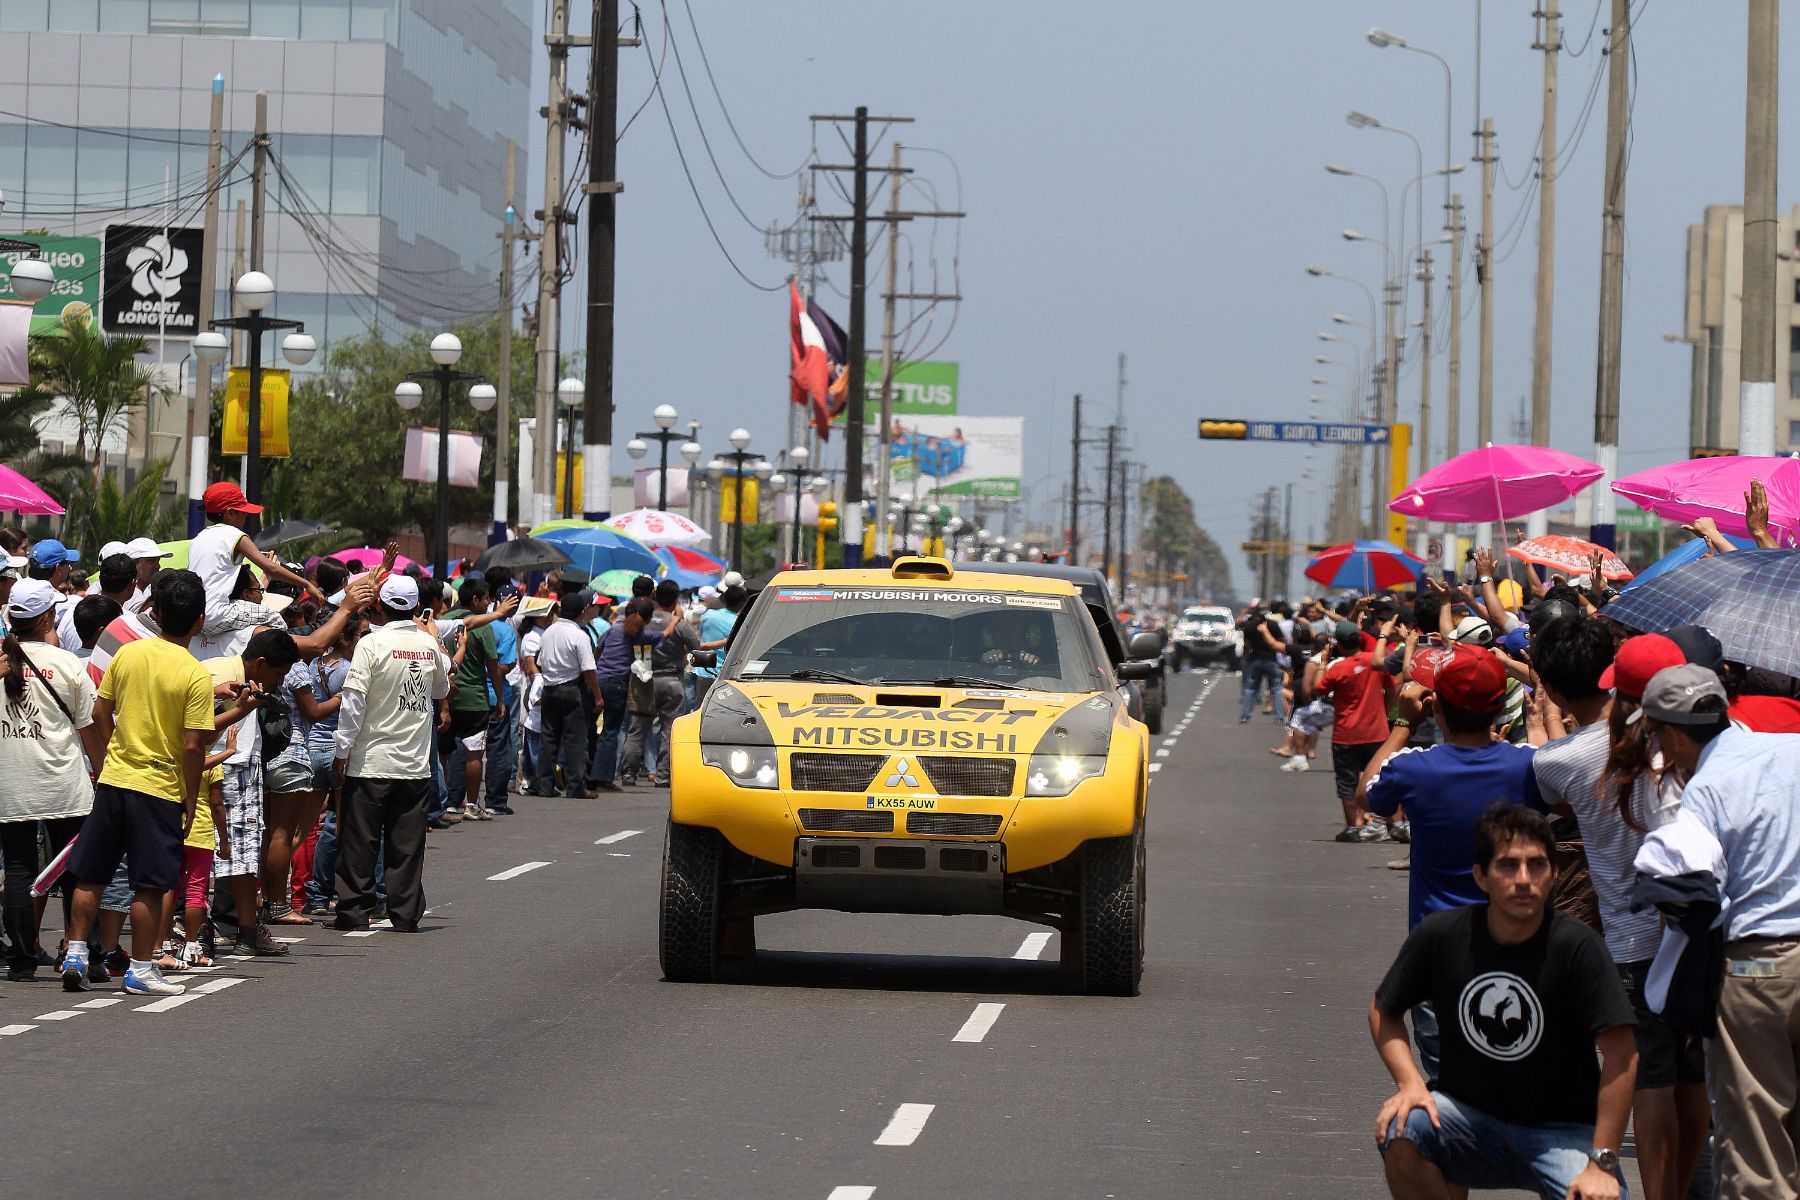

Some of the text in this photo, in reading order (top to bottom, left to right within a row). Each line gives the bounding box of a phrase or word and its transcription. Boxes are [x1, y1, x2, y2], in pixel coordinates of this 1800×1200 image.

[132, 300, 180, 312] BOART
[117, 311, 195, 327] LONGYEAR
[832, 591, 1002, 604] MITSUBISHI MOTORS
[392, 650, 433, 660] CHORRILLOS
[399, 695, 428, 712] DAKAR
[777, 702, 1037, 724] VEDACIT
[1, 720, 46, 740] DAKAR
[792, 727, 1017, 752] MITSUBISHI
[877, 798, 935, 809] KX55 AUW
